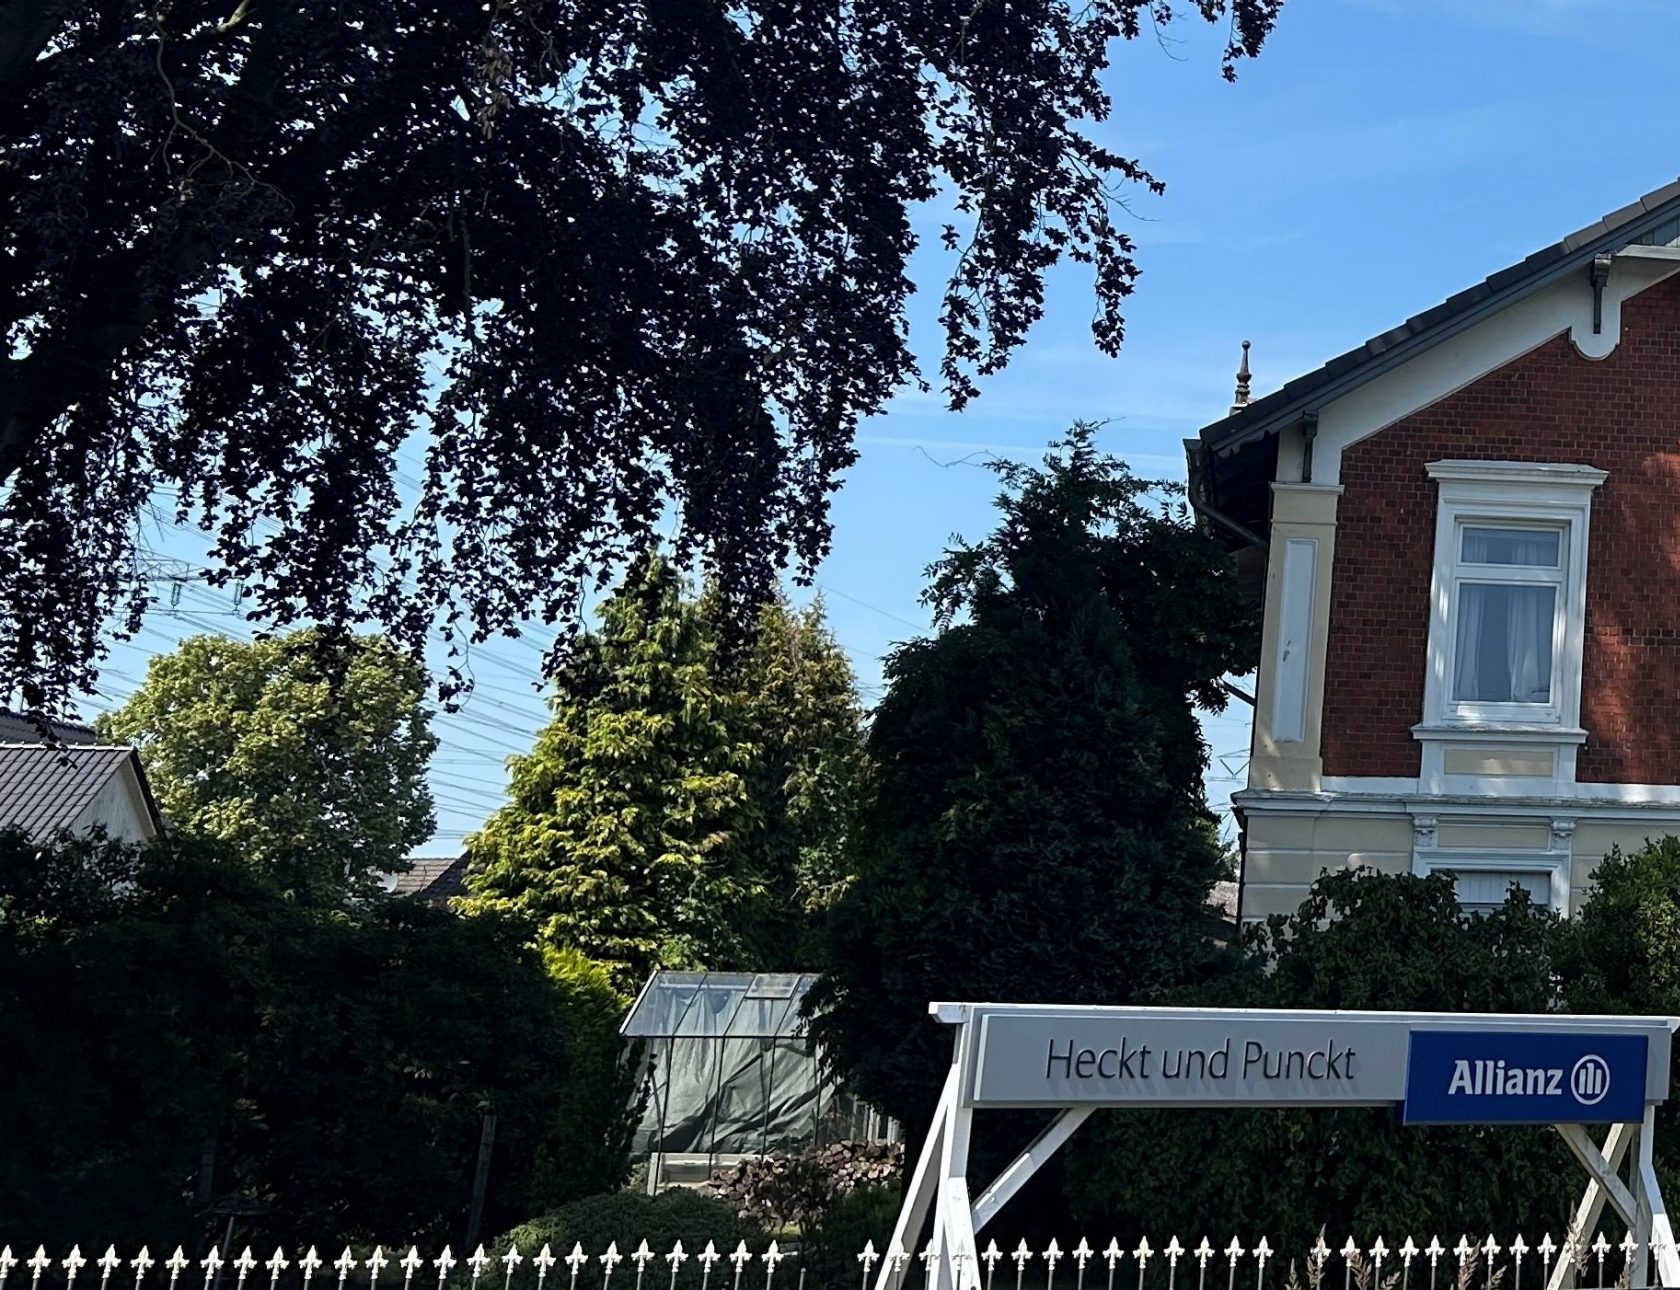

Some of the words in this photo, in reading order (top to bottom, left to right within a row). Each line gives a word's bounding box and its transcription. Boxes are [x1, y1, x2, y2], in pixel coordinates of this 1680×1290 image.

[1046, 1036, 1151, 1080] Heckt
[1161, 1037, 1232, 1080] und
[1242, 1038, 1357, 1081] Punckt
[1447, 1059, 1564, 1096] Allianz
